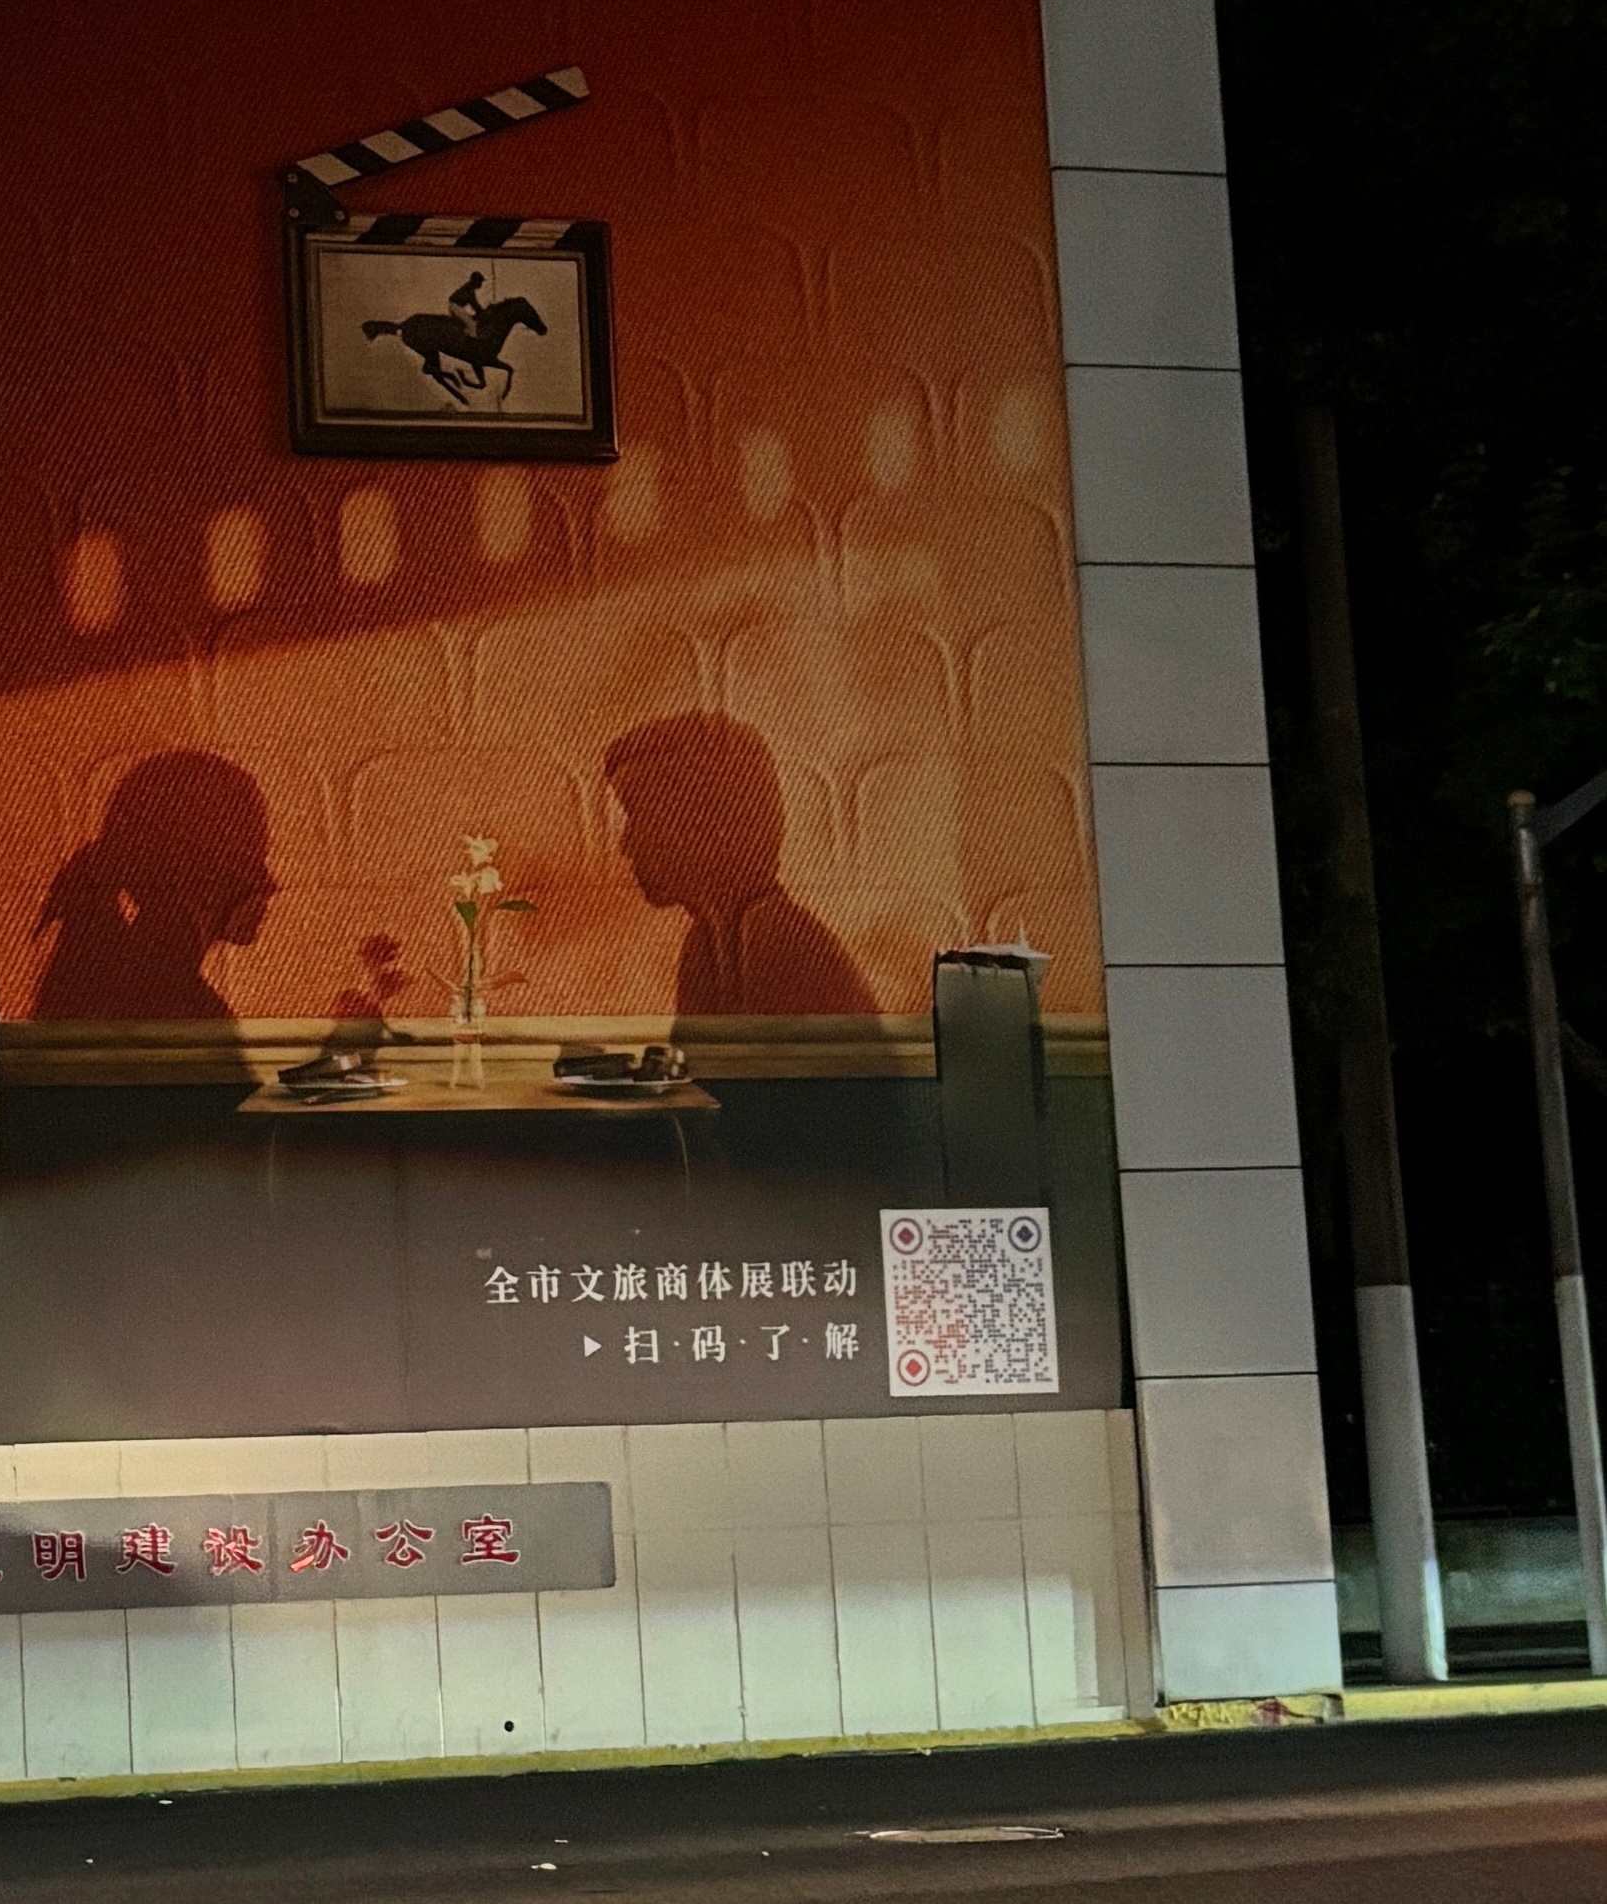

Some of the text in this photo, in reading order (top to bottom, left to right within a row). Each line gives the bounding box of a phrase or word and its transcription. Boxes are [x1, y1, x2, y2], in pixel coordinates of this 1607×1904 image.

[483, 1258, 859, 1305] 全市文旅商体展联动
